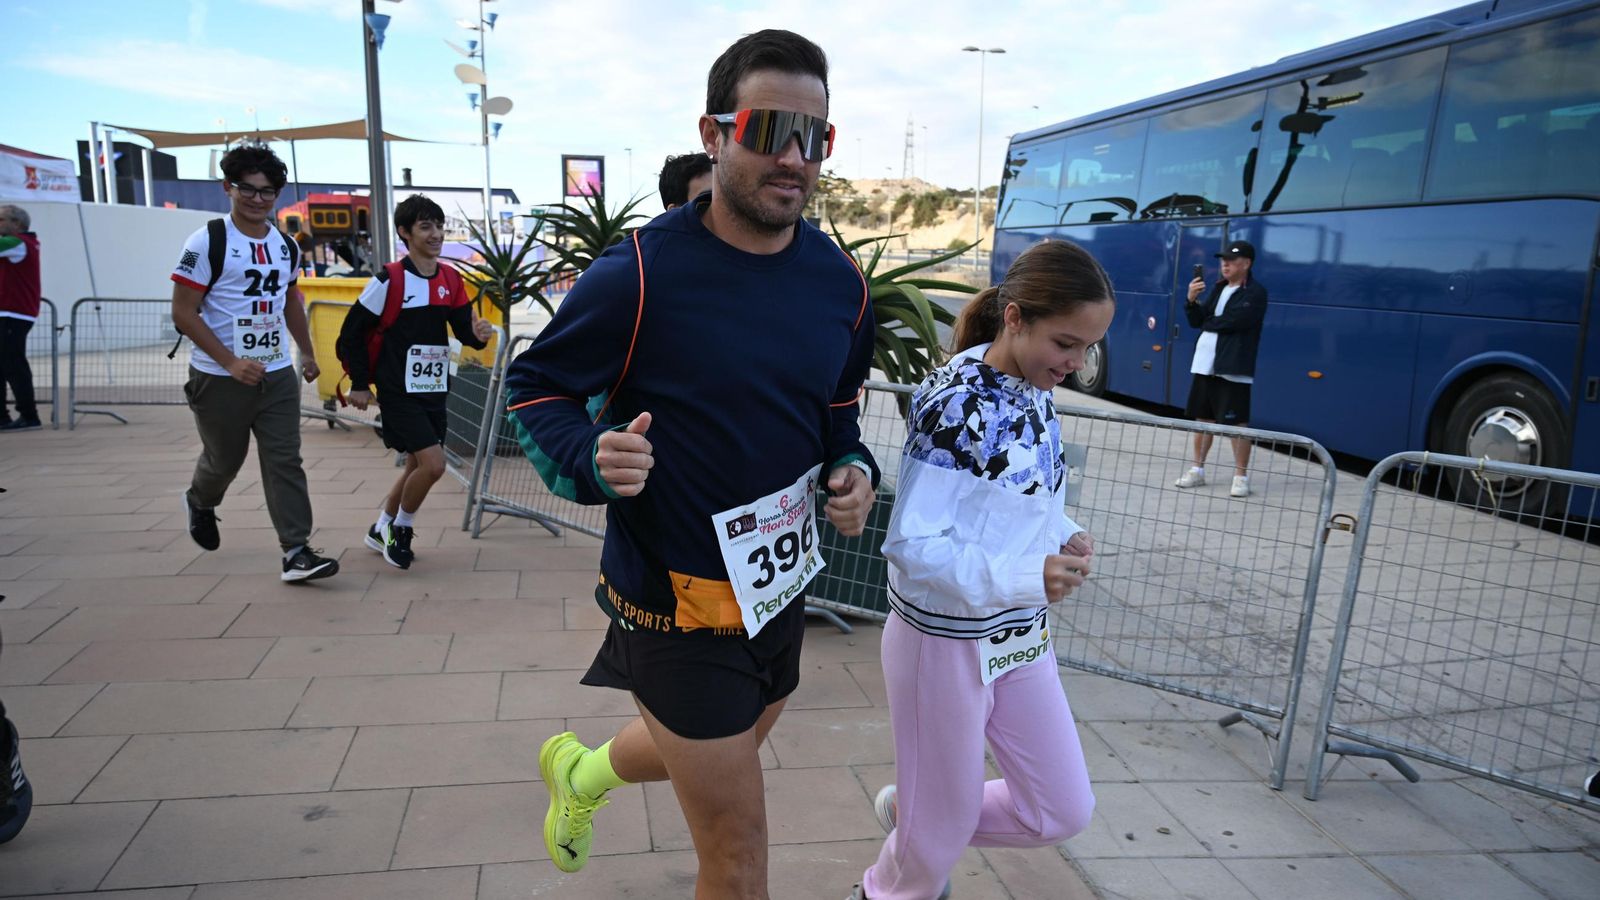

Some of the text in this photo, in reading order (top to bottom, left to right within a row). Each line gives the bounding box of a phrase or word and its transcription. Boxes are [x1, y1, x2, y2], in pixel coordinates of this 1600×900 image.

[243, 268, 281, 297] 24
[242, 330, 280, 350] 945
[412, 362, 444, 378] 943
[780, 494, 789, 509] 6
[759, 518, 786, 535] Non
[786, 500, 807, 526] Stop
[747, 512, 813, 590] 396
[753, 555, 817, 624] Peregrin
[607, 584, 672, 633] NIKE SPORTS
[713, 624, 744, 636] NIKE
